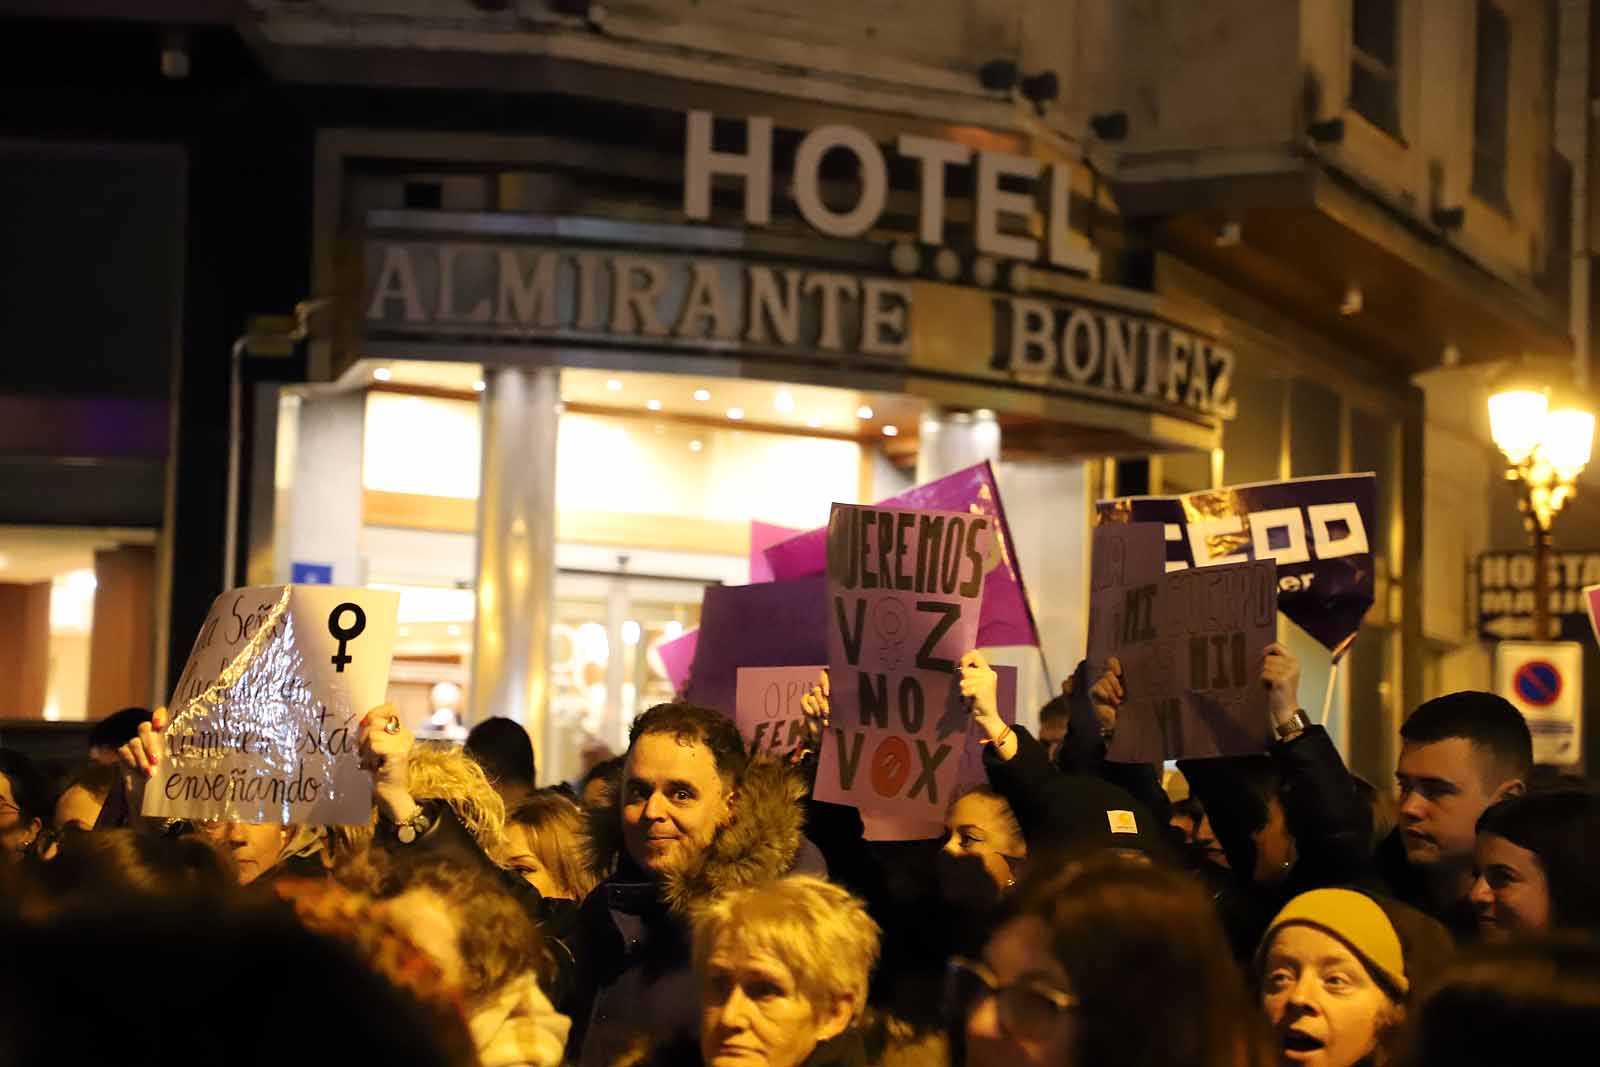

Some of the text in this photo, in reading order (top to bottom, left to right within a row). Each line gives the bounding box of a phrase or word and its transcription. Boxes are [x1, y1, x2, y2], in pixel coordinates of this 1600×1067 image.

[685, 110, 1099, 280] HOTEL
[366, 243, 1237, 420] ALMIRANTE BONIFAZ
[858, 672, 925, 733] NO
[165, 765, 322, 804] enseñando
[834, 728, 952, 805] VOX
